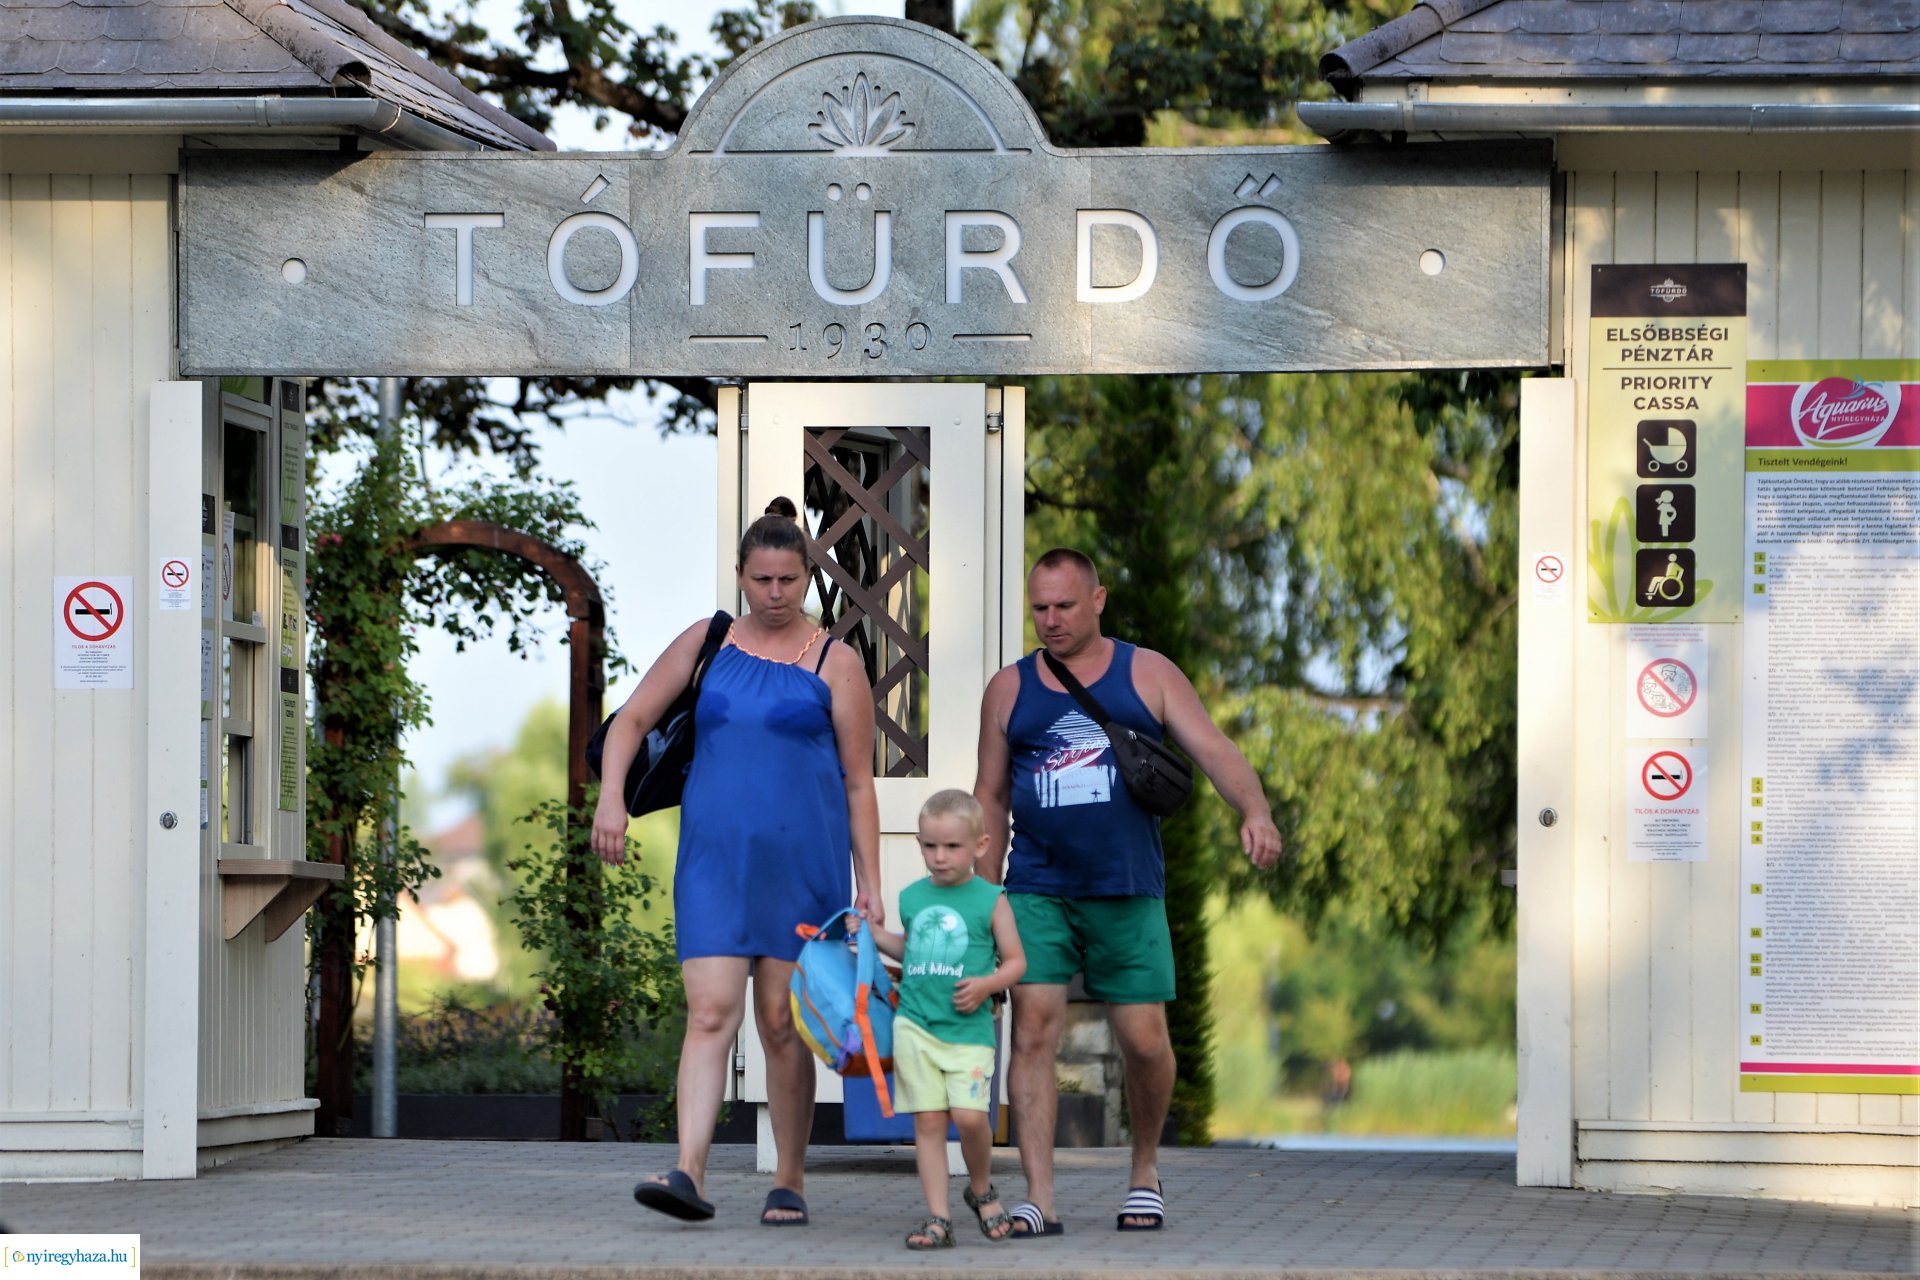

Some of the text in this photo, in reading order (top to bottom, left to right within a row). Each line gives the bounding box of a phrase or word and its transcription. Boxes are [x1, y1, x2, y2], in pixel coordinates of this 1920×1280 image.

[423, 172, 1301, 307] TÓFÜRDŐ
[789, 321, 933, 359] 1930
[1606, 324, 1728, 342] ELSŐBBSÉGI
[1621, 344, 1714, 362] PÉNZTÁR
[1620, 376, 1713, 390] PRIORITY
[1633, 396, 1700, 410] CASSA
[1798, 392, 1890, 439] Aquarius
[1758, 457, 1848, 468] Tisztelt Vendégeink!
